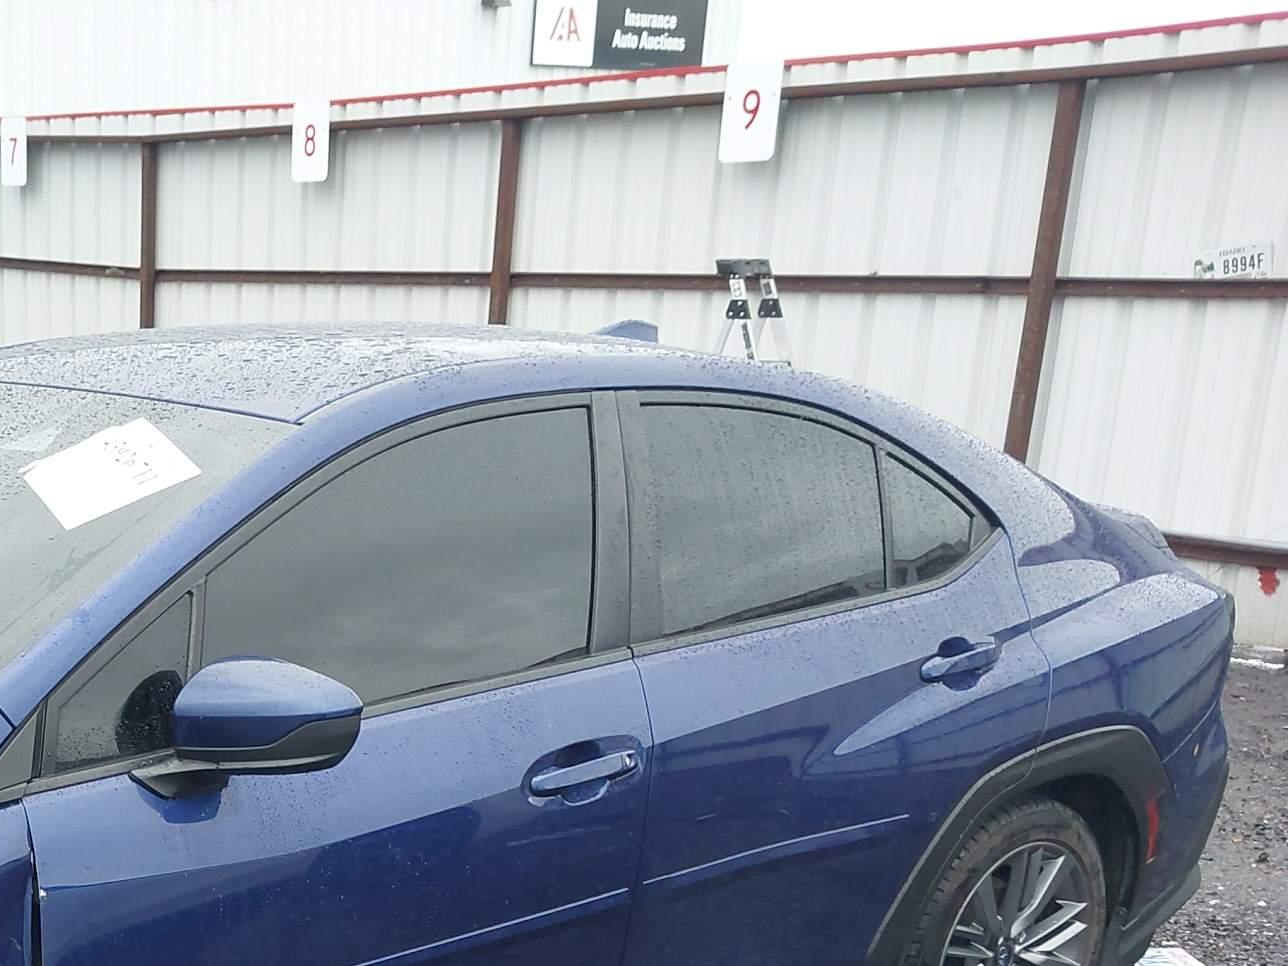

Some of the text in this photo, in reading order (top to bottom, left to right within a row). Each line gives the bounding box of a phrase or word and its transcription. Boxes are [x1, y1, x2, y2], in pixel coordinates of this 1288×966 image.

[623, 7, 678, 30] Insurance
[611, 28, 686, 52] Auto Auctions
[742, 89, 761, 131] 9
[9, 136, 18, 167] 7
[304, 124, 316, 157] 8
[1222, 252, 1265, 276] 8994F
